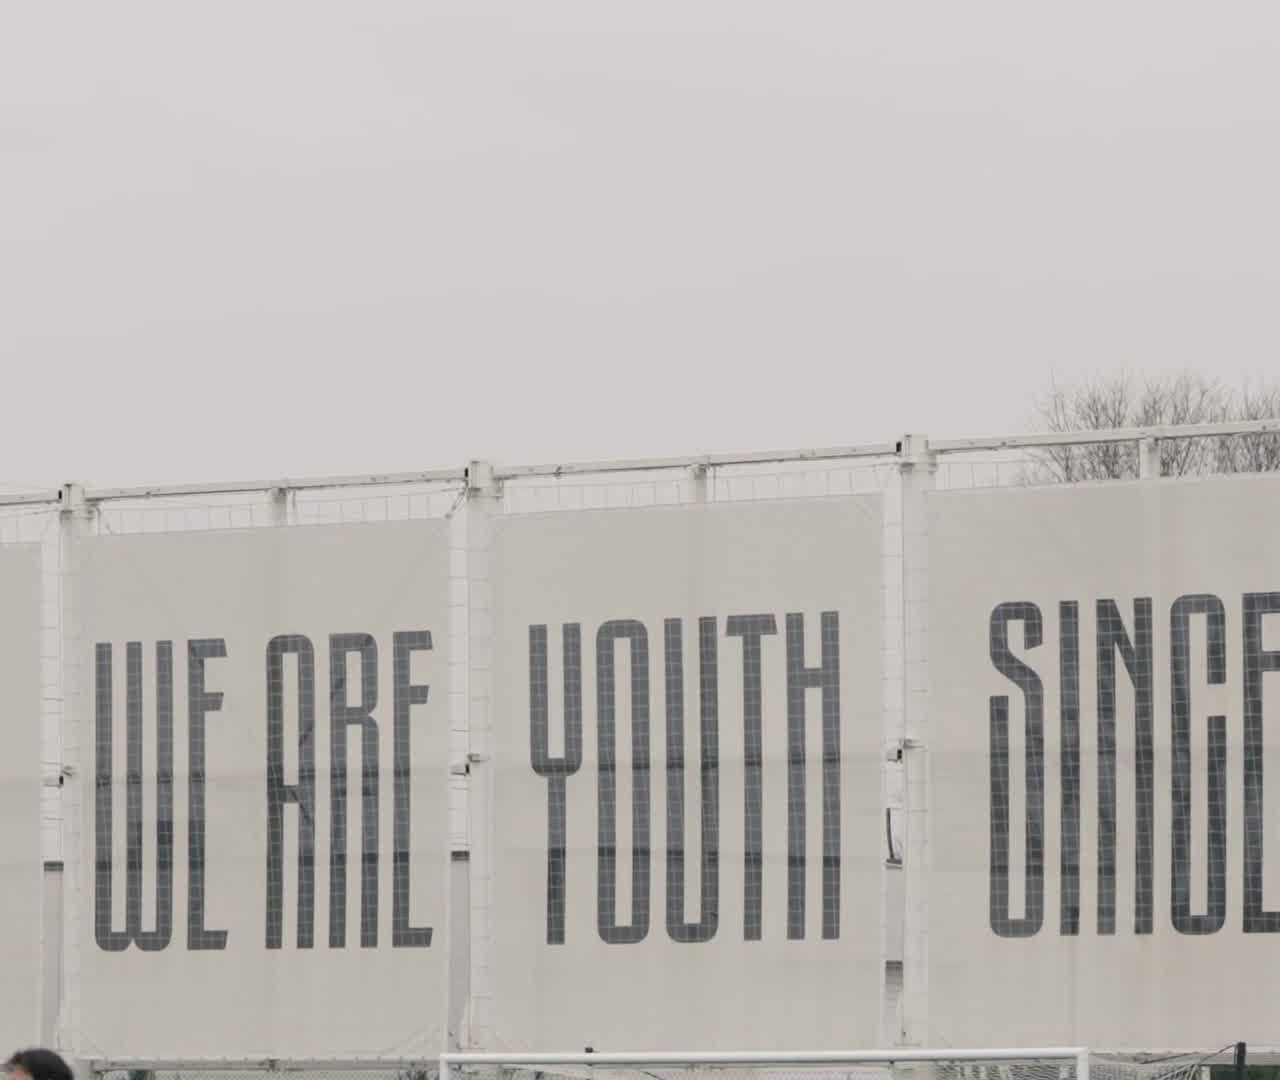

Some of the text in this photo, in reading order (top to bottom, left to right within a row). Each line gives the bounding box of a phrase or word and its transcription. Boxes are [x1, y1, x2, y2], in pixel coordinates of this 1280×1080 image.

[94, 637, 228, 951] WE
[264, 629, 433, 949] ARE
[528, 610, 841, 945] YOUTH
